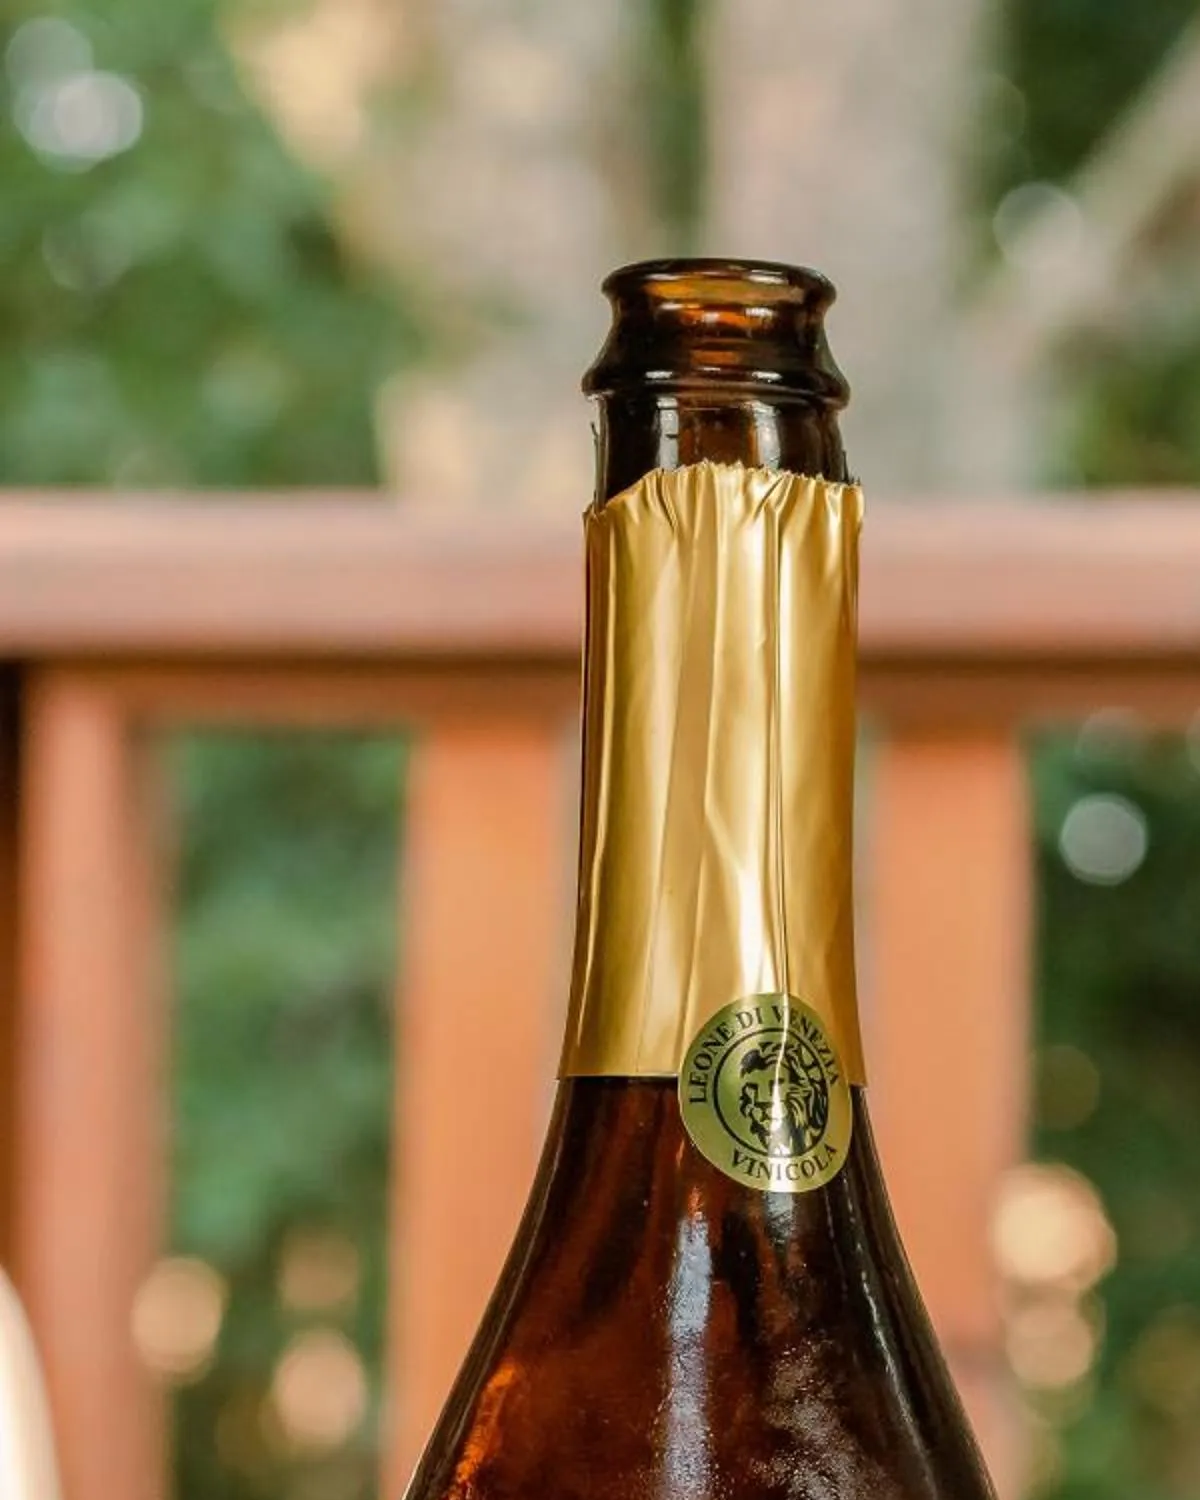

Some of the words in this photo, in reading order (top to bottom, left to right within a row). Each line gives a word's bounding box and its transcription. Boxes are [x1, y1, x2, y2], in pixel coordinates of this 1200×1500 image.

[689, 1022, 734, 1104] LEONE
[736, 1007, 763, 1030] DI
[731, 1143, 837, 1181] VINICOLA
